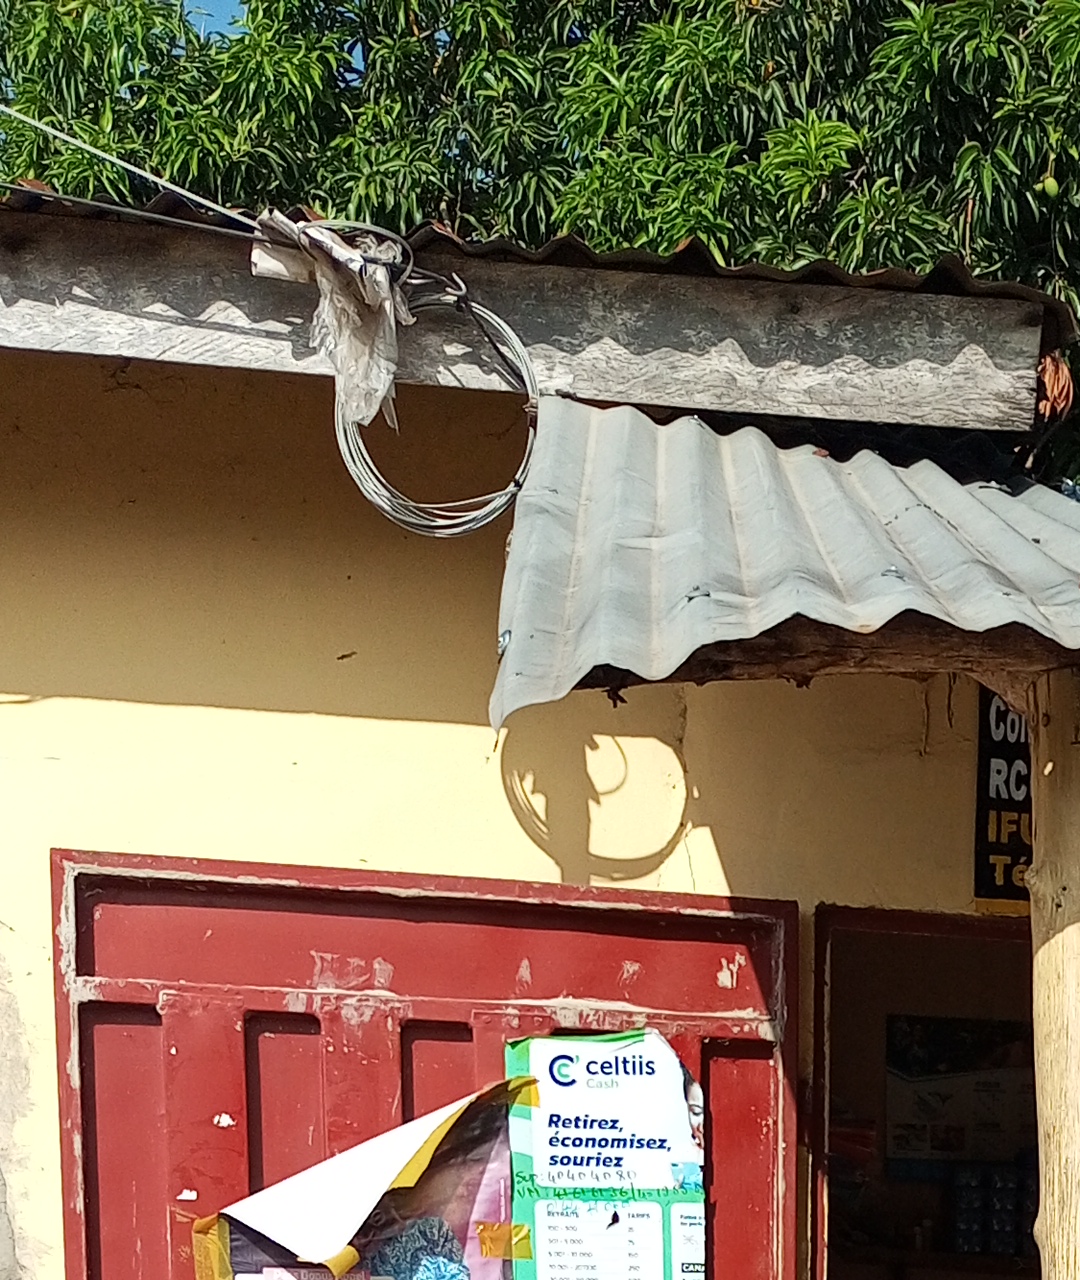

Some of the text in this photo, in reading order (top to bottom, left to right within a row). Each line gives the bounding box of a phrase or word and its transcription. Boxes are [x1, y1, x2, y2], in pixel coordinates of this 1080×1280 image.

[586, 1055, 656, 1076] celtiis
[548, 1113, 624, 1133] Retirez,
[548, 1132, 672, 1152] économisez,
[549, 1152, 624, 1168] souriez
